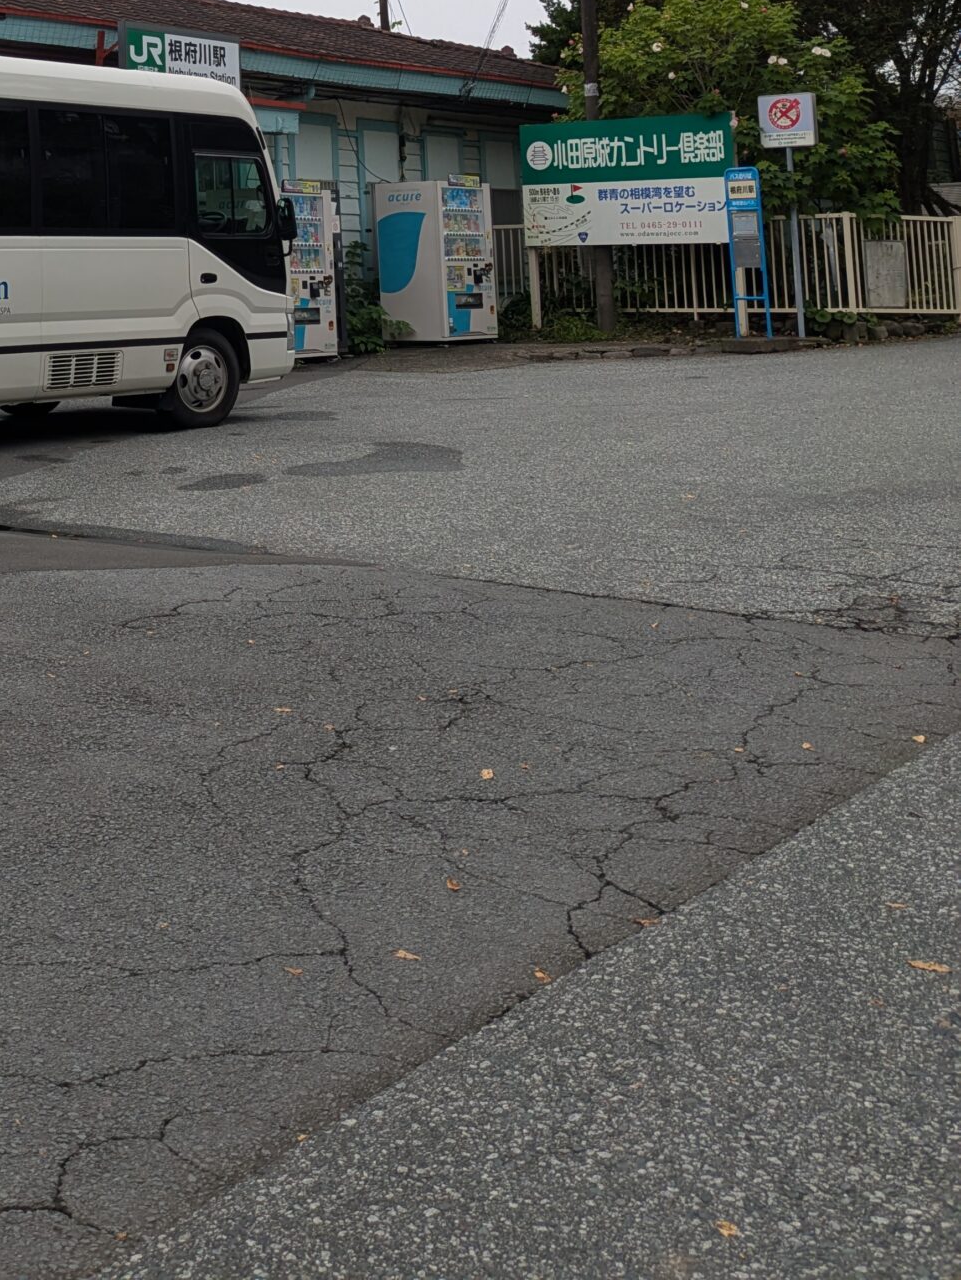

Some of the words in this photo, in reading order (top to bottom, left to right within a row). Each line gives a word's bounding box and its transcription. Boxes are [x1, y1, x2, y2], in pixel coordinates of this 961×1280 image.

[129, 35, 163, 65] JR
[168, 39, 226, 67] 根府川駅
[553, 130, 725, 169] 小田原城カントリー倶楽部
[388, 191, 422, 202] acure
[598, 185, 695, 201] 群青の相模湾を望む
[620, 201, 727, 215] スーパーロケーション
[620, 222, 637, 230] TEL
[641, 220, 703, 229] 0465-29-0111
[0, 306, 11, 315] SPA
